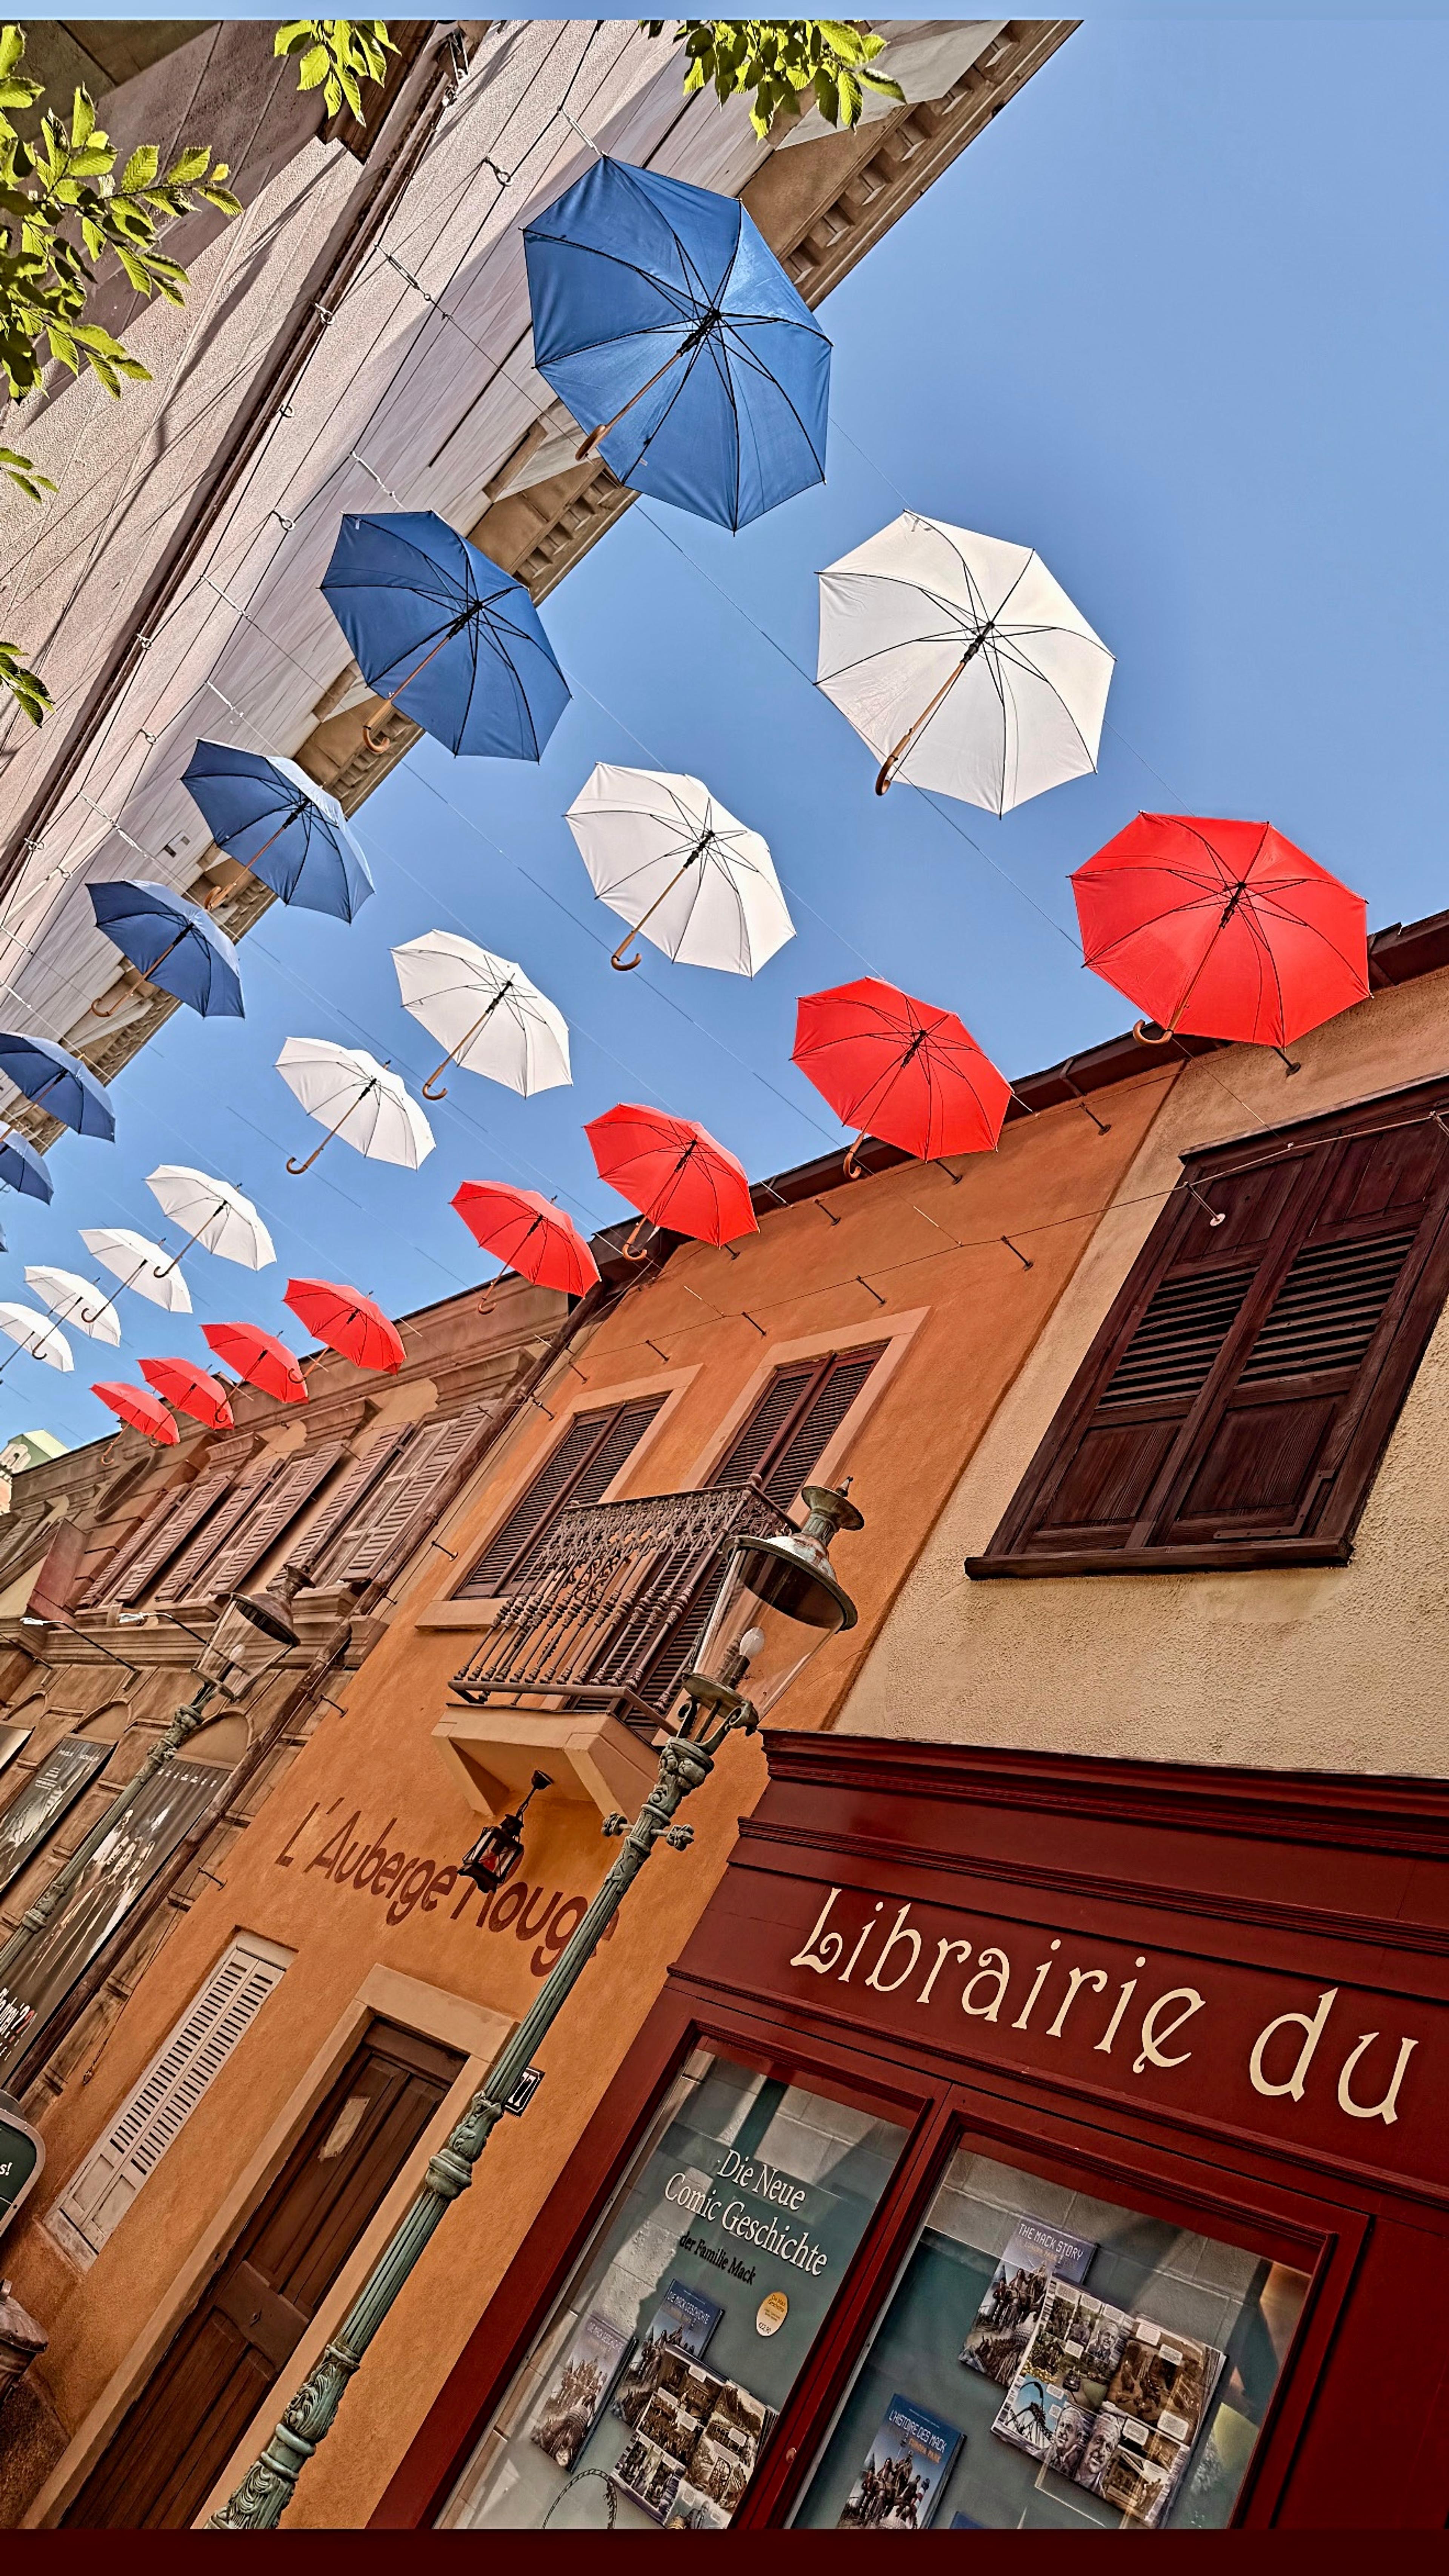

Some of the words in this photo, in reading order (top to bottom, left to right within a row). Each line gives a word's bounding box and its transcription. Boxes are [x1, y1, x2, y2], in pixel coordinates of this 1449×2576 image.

[790, 1888, 1206, 2074] Librairie
[1249, 1987, 1419, 2144] du
[0, 2162, 13, 2176] s!
[717, 2149, 754, 2187] Die
[752, 2164, 806, 2211] Neue
[665, 2173, 722, 2221] Comic
[722, 2201, 827, 2276] Geschichte
[1018, 2223, 1035, 2240] THE
[1034, 2231, 1057, 2250] MACK
[1055, 2241, 1083, 2261] STORY
[680, 2231, 696, 2252] der
[695, 2239, 729, 2270] Familie
[727, 2257, 756, 2285] Mack
[916, 2427, 931, 2443] DES
[928, 2434, 947, 2453] MACK
